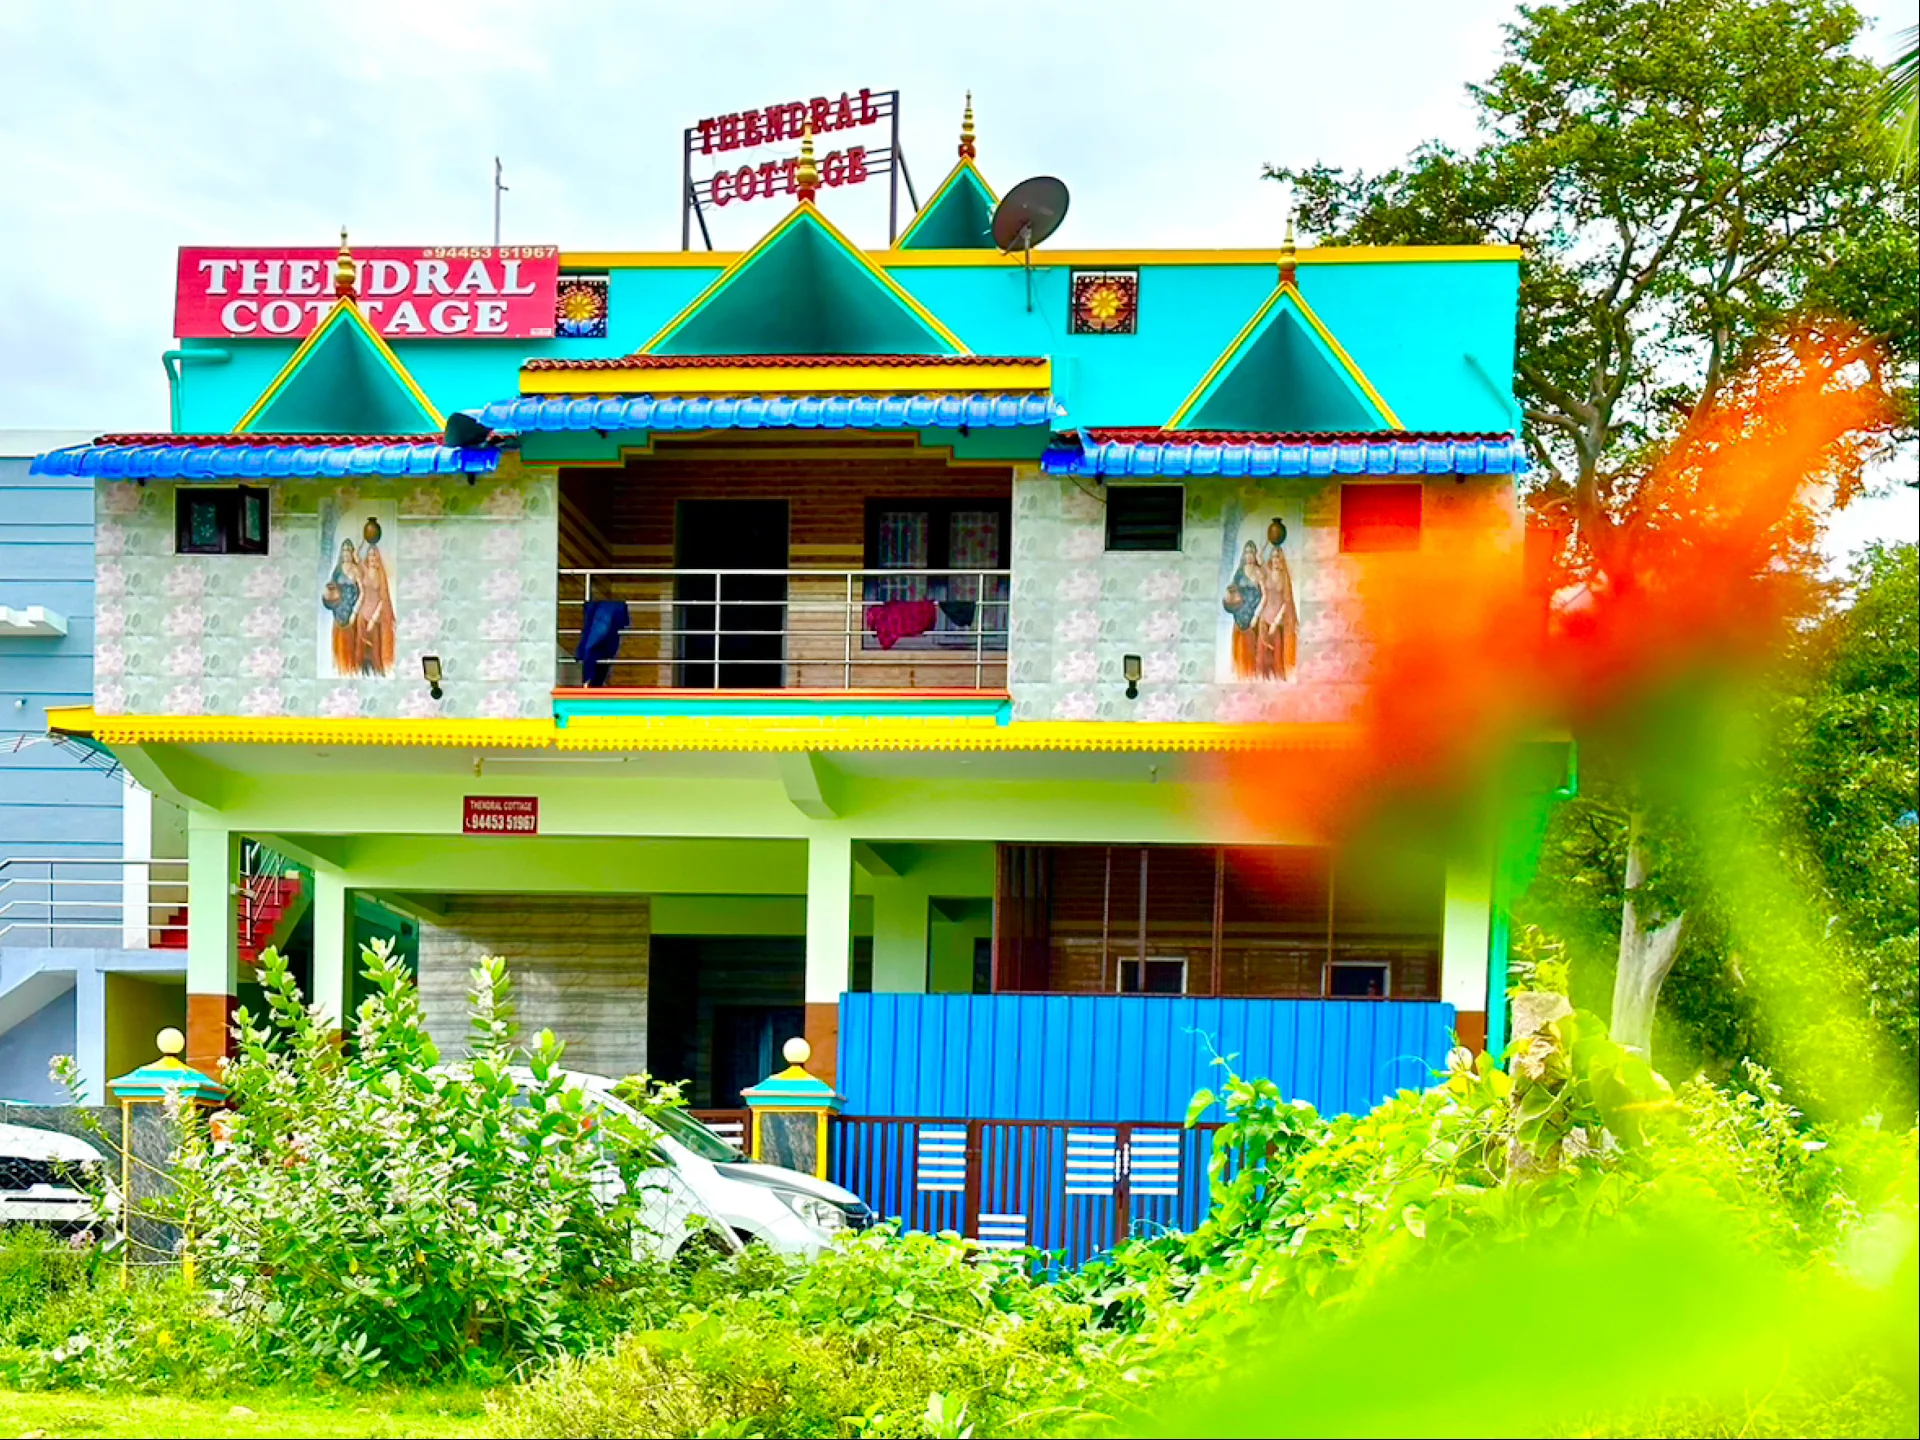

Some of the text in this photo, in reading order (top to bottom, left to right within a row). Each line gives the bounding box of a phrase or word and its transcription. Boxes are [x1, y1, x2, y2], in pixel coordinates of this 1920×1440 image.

[698, 88, 879, 155] THENDRAL
[711, 145, 868, 207] COTTGE
[434, 247, 556, 259] 94453 51967
[470, 800, 533, 811] THENDRAL COTTAGE
[472, 813, 536, 831] 94453 51967
